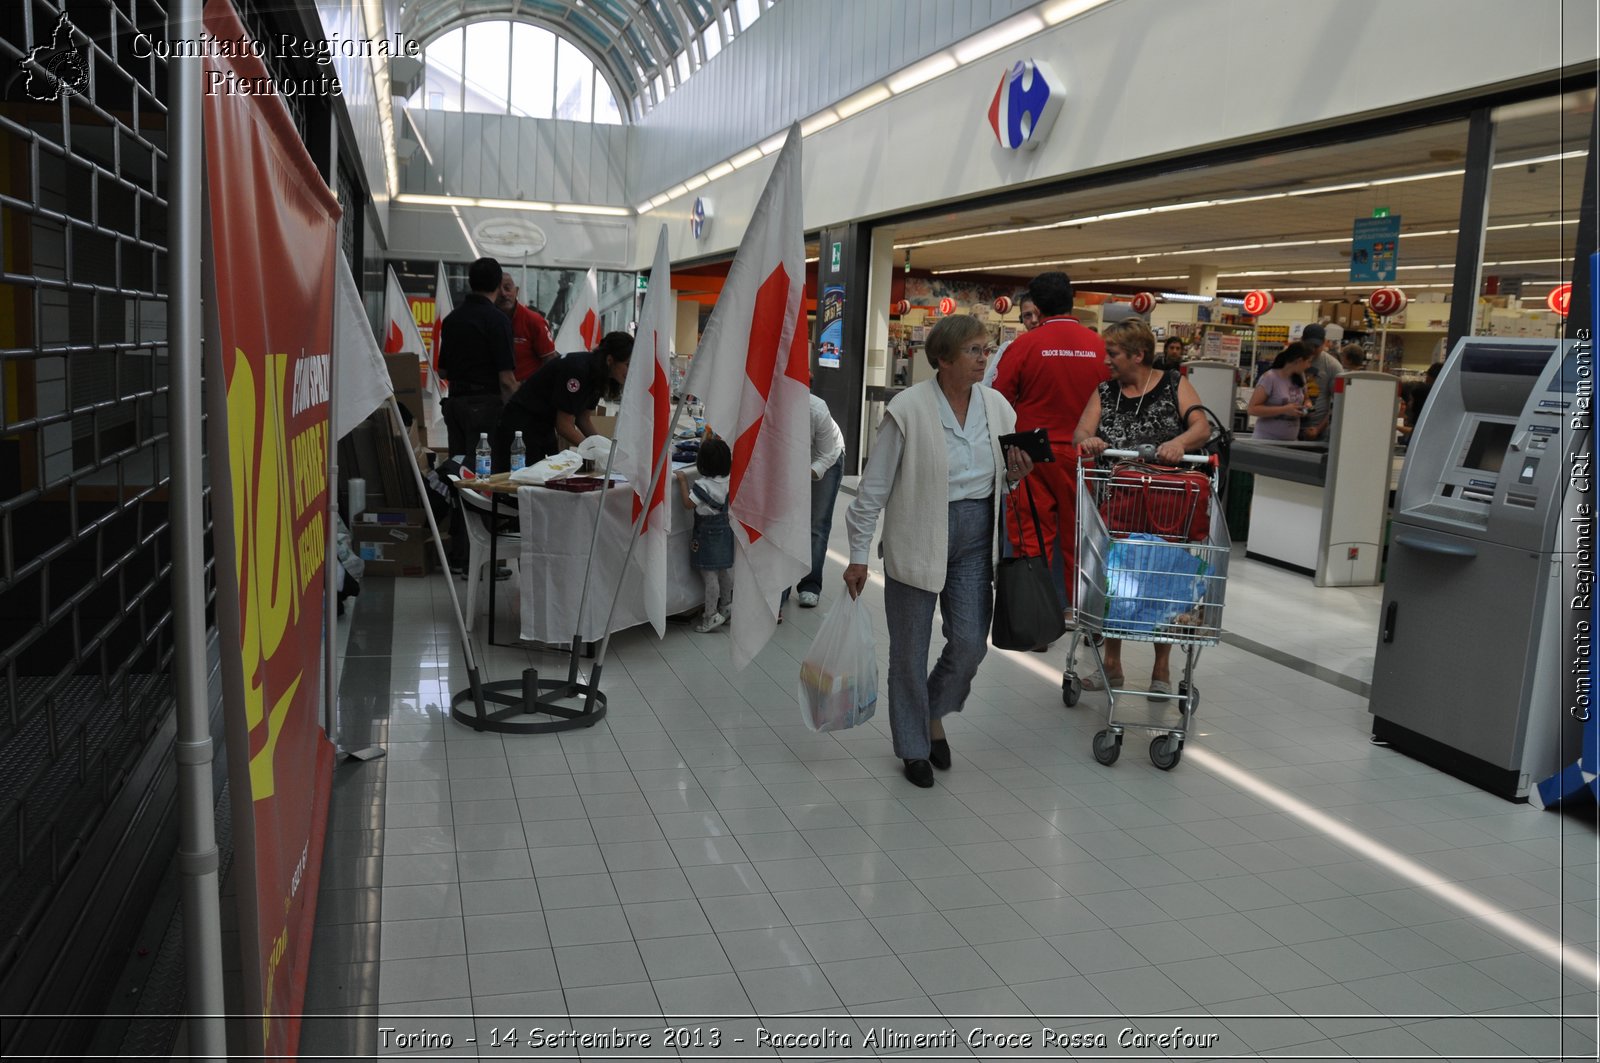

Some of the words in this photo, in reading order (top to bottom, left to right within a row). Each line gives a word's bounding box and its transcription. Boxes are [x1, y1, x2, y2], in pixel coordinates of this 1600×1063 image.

[1248, 296, 1256, 308] 3
[1375, 294, 1385, 307] 2
[1041, 349, 1058, 358] CROCE
[1059, 349, 1073, 358] ROSSA
[1074, 350, 1097, 359] ITALIANA
